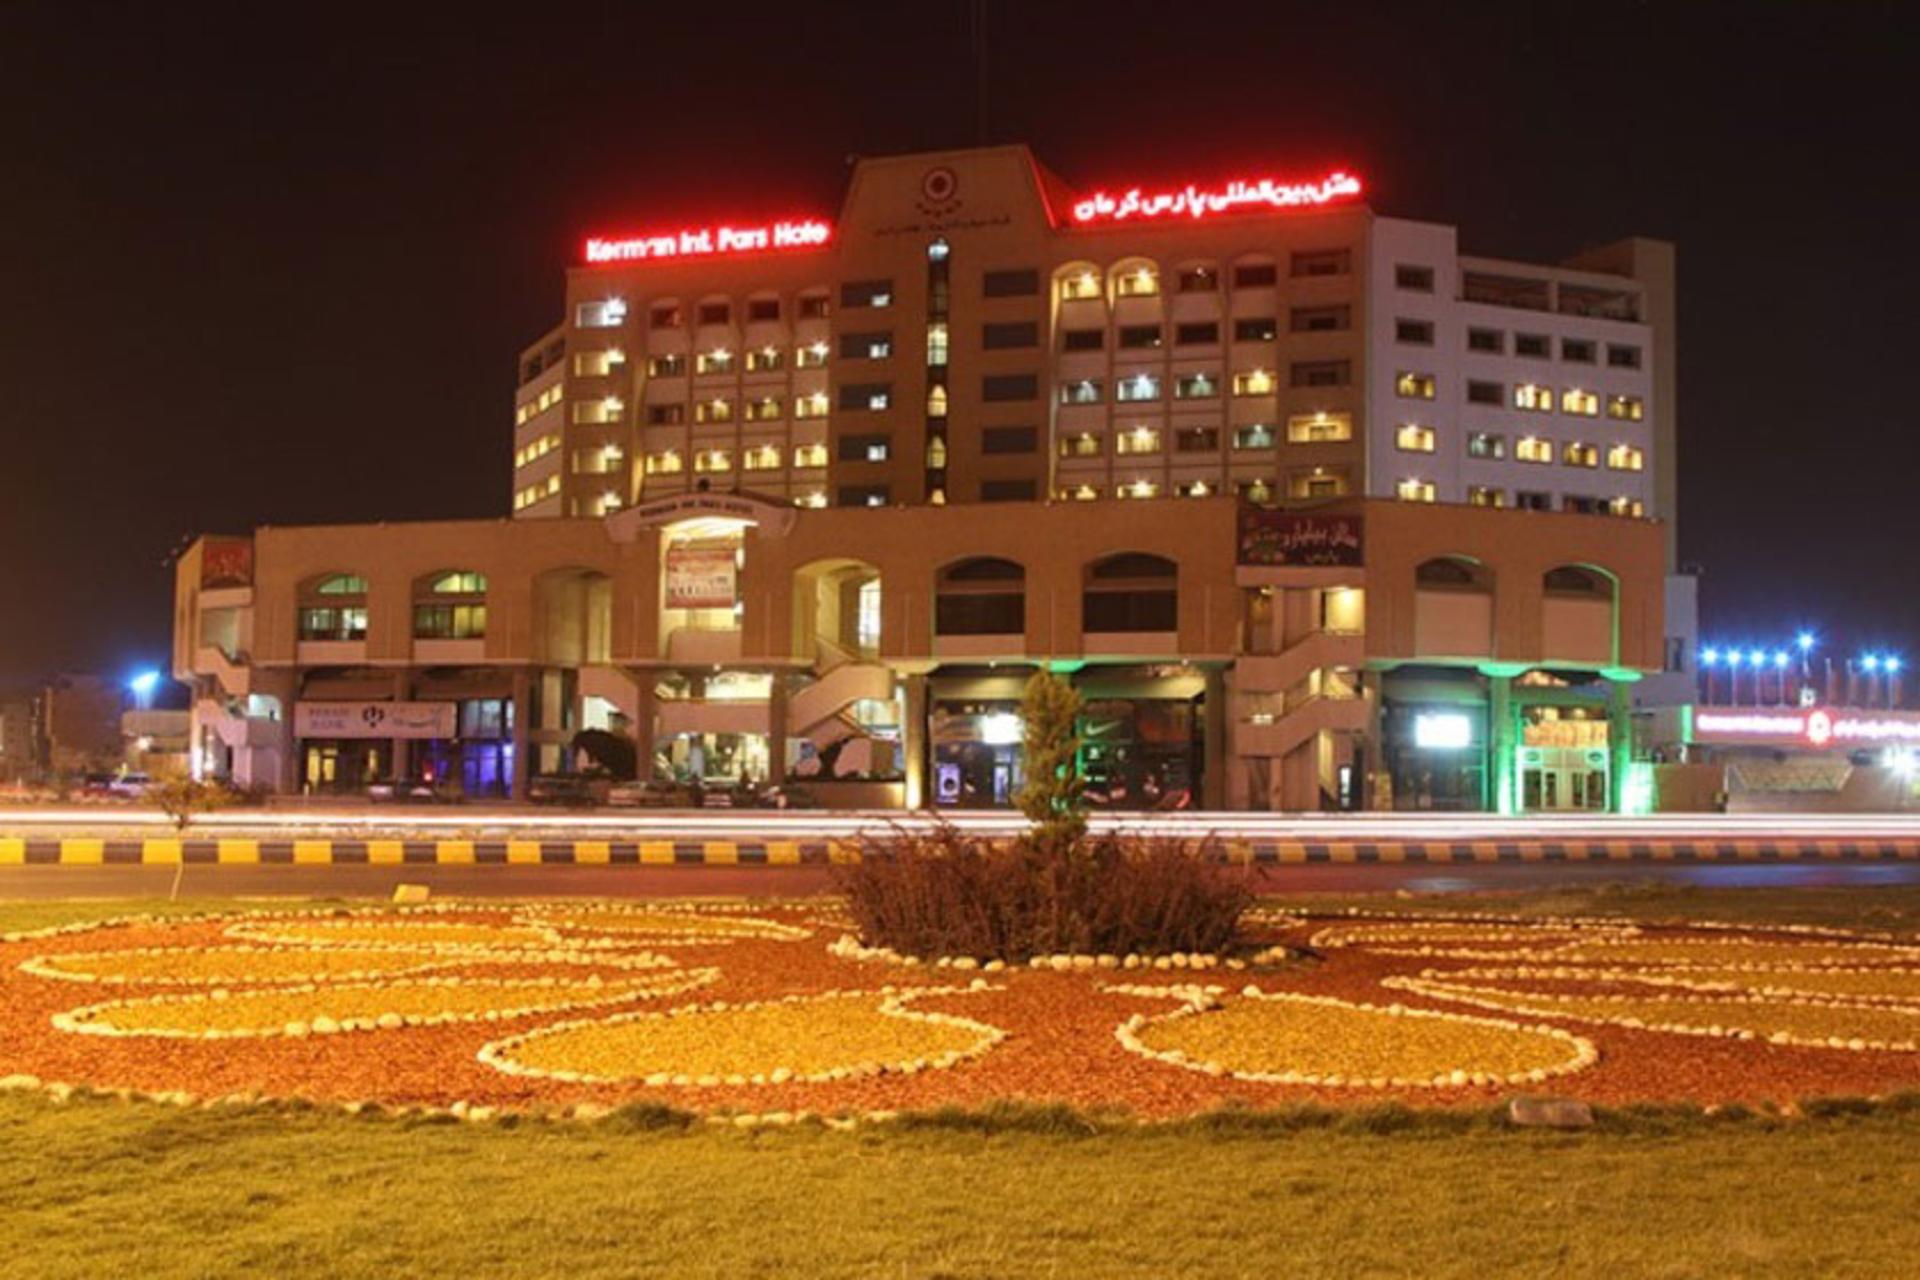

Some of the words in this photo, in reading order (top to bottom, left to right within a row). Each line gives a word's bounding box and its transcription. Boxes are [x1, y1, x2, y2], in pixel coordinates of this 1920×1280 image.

[1140, 187, 1207, 218] پارس
[1315, 173, 1360, 204] هتل
[1074, 190, 1141, 221] کرمان
[586, 237, 677, 262] Kerman
[717, 227, 768, 251] Pars
[774, 220, 829, 247] Hote
